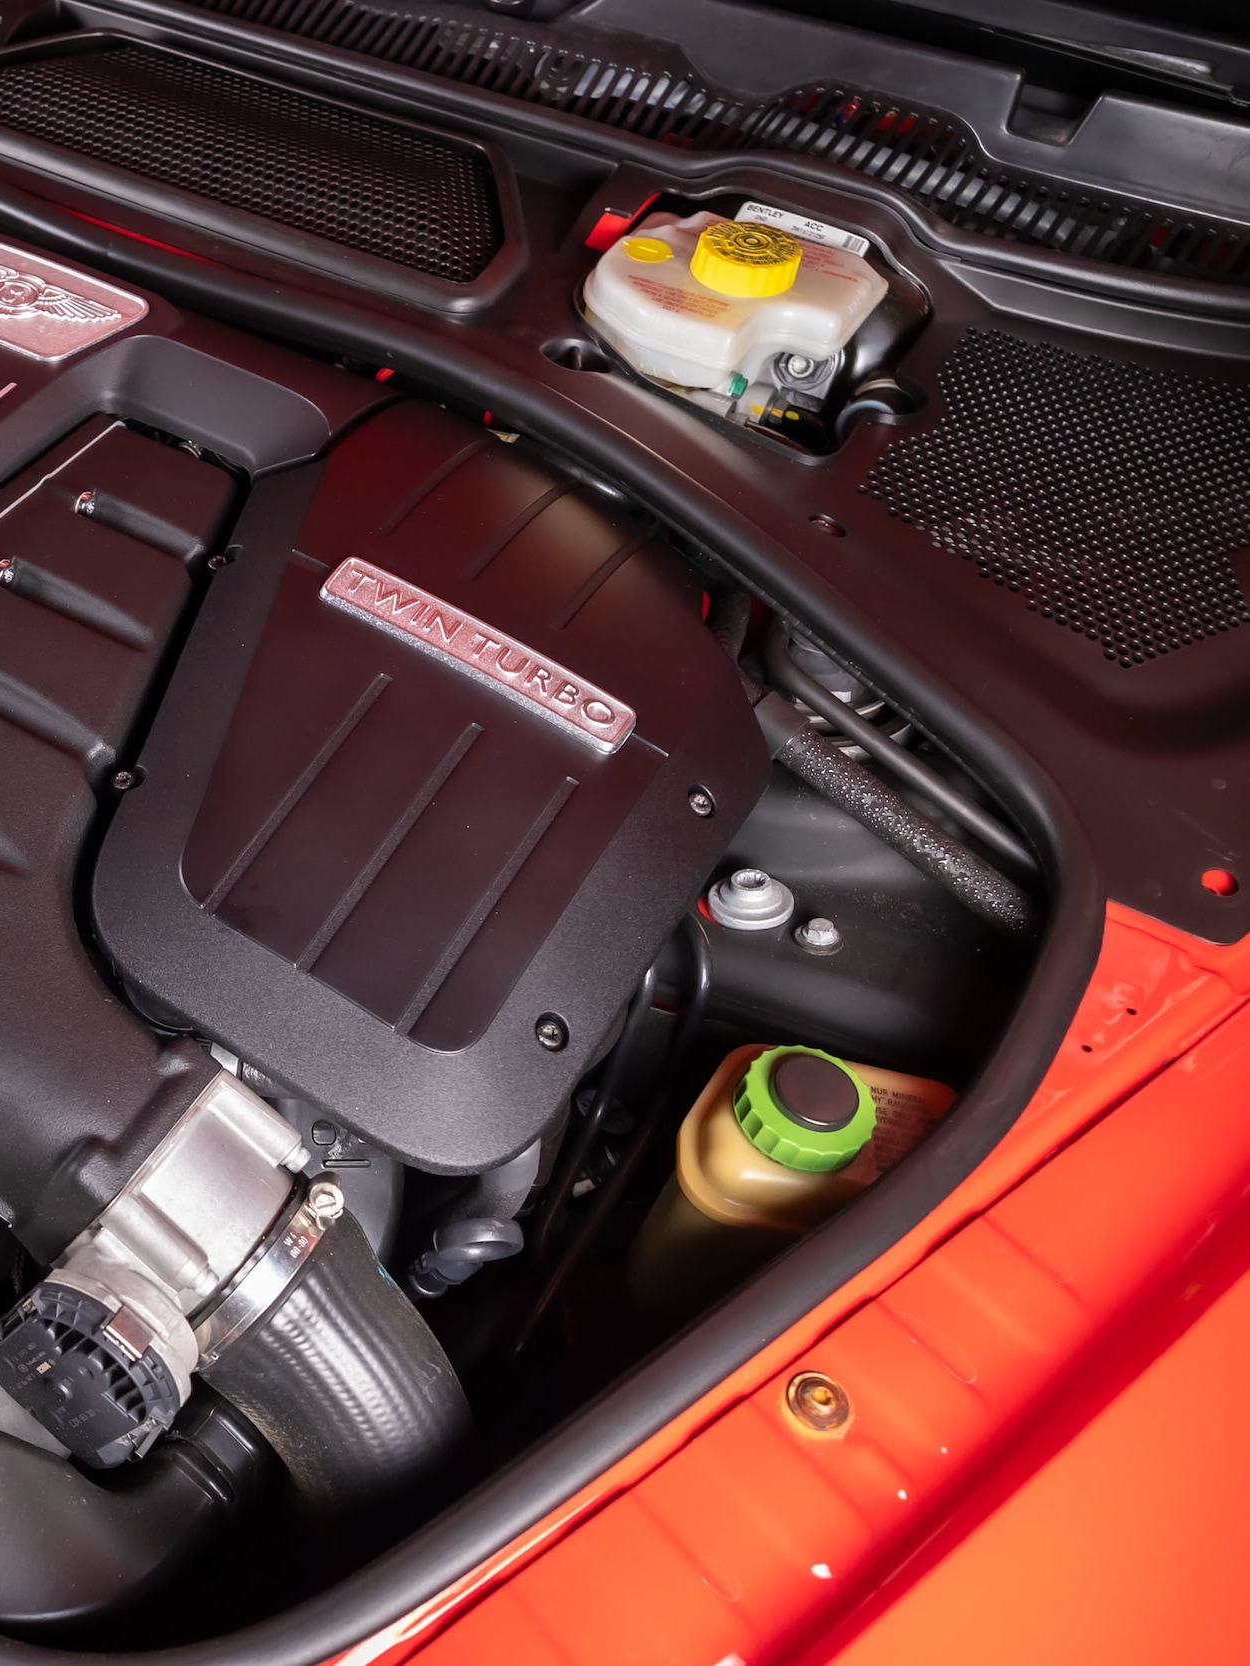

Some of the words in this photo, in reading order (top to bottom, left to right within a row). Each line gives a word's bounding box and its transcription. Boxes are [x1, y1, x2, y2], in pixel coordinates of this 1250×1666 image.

[747, 204, 784, 219] BENTLEY
[803, 221, 825, 232] ACC
[347, 568, 464, 644] TWIN
[471, 632, 617, 728] TURBO
[871, 1086, 888, 1097] NUR
